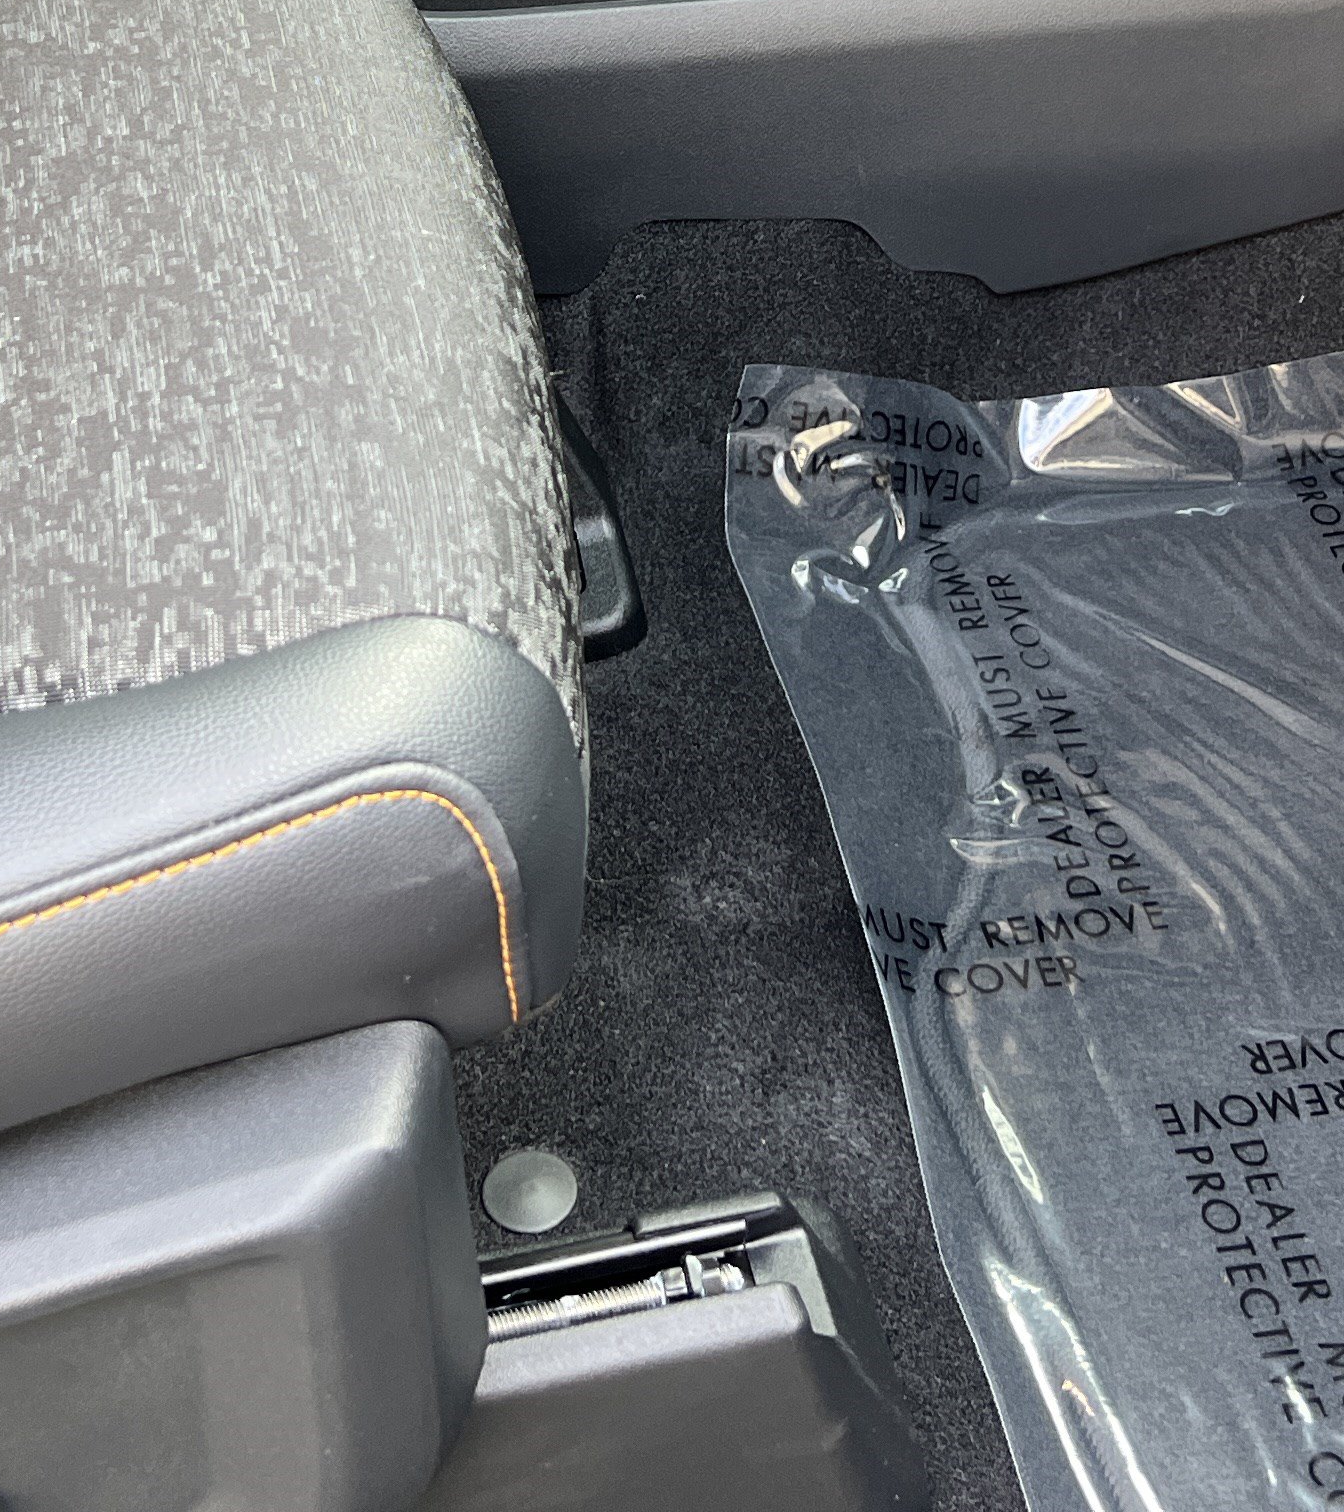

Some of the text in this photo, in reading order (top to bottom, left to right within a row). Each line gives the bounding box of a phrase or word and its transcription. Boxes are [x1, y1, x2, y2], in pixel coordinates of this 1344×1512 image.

[919, 510, 1102, 899] DEALER MUST REMOVE
[986, 573, 1150, 893] PROTECTIVE COVER
[934, 955, 1086, 997] COVER
[980, 901, 1168, 949] REMOVE
[1175, 1145, 1328, 1424] PROTECTIVE
[1229, 1139, 1331, 1304] DEALER
